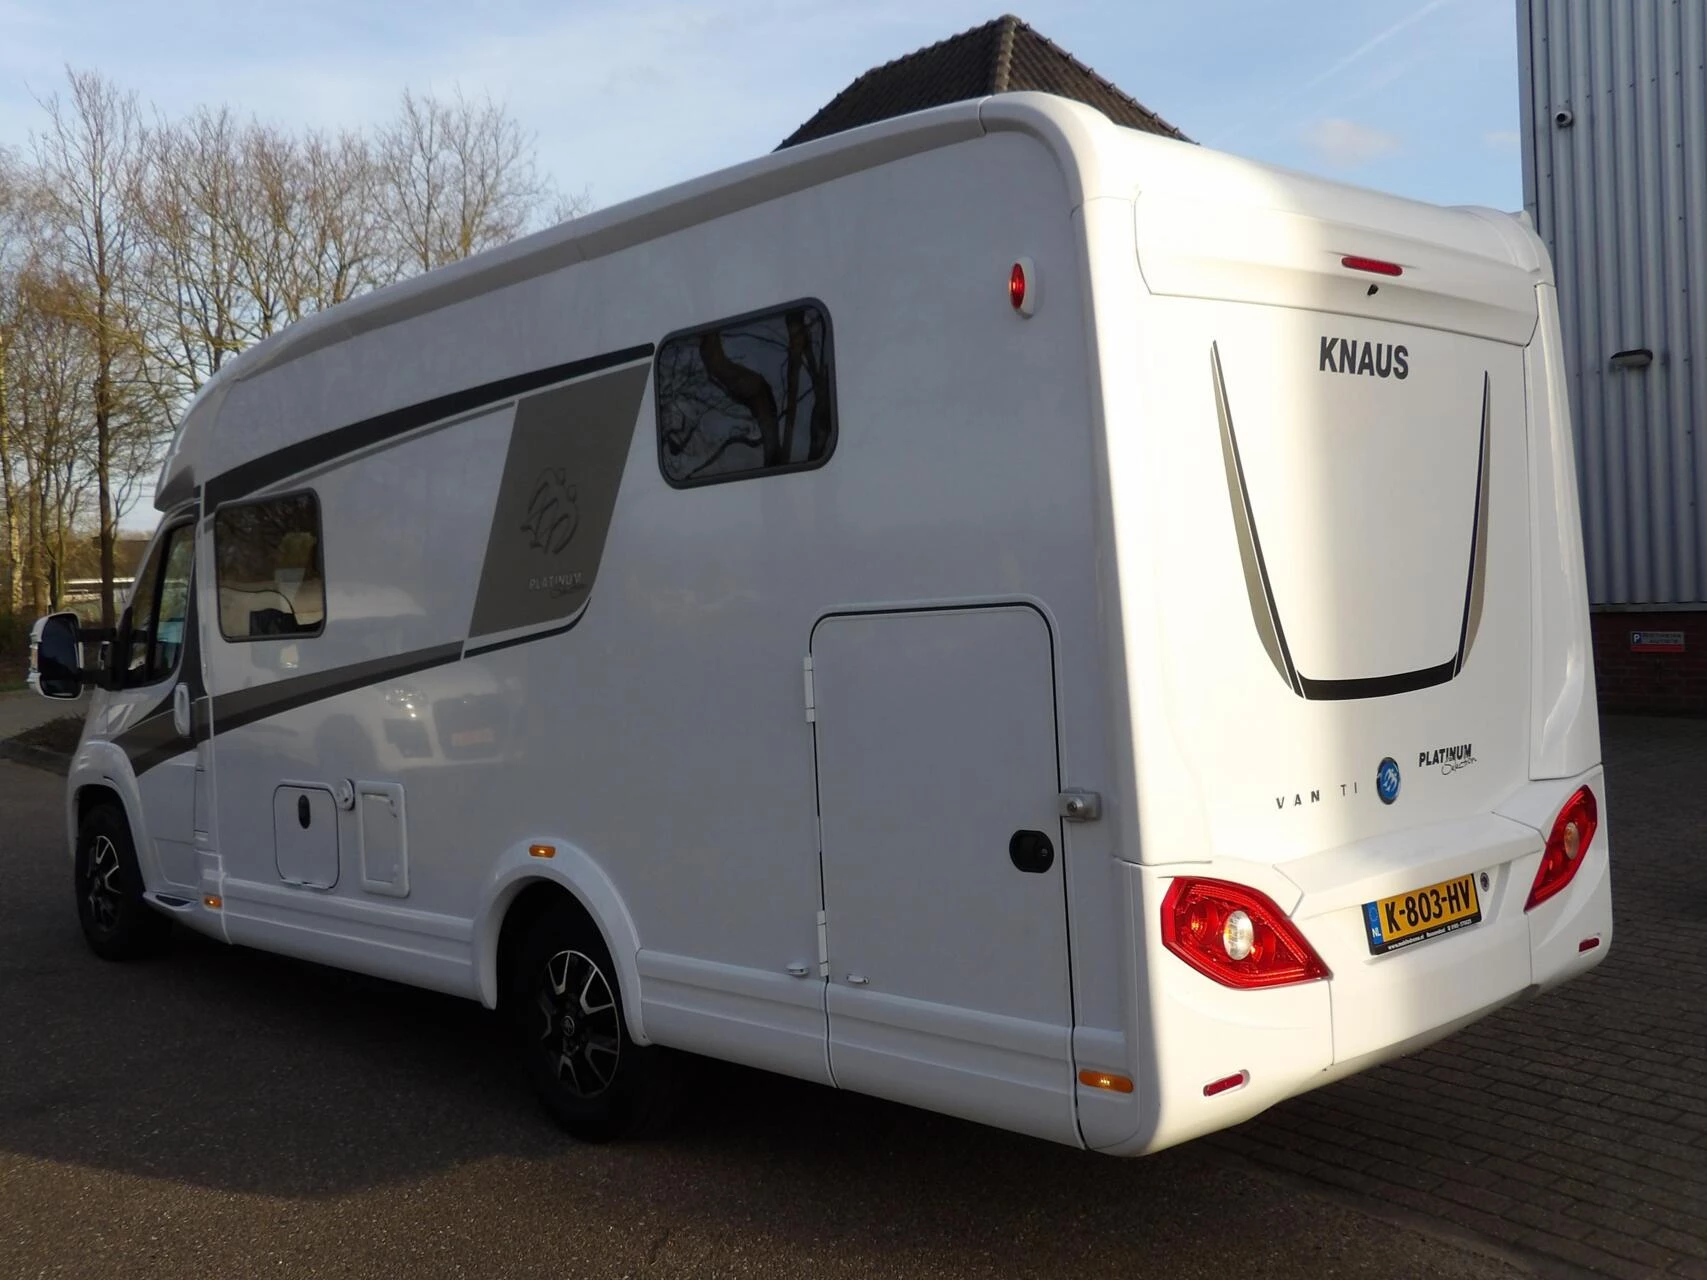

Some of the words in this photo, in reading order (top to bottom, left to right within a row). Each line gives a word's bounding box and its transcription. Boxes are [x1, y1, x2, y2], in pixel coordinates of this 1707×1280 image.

[1319, 336, 1409, 380] KNAUS
[528, 572, 583, 590] PLATINUM
[1418, 743, 1473, 768] PLATINUM
[1275, 789, 1321, 810] VAN
[1340, 781, 1358, 797] TI
[1384, 879, 1471, 934] K-803-HV
[1371, 927, 1382, 938] NL
